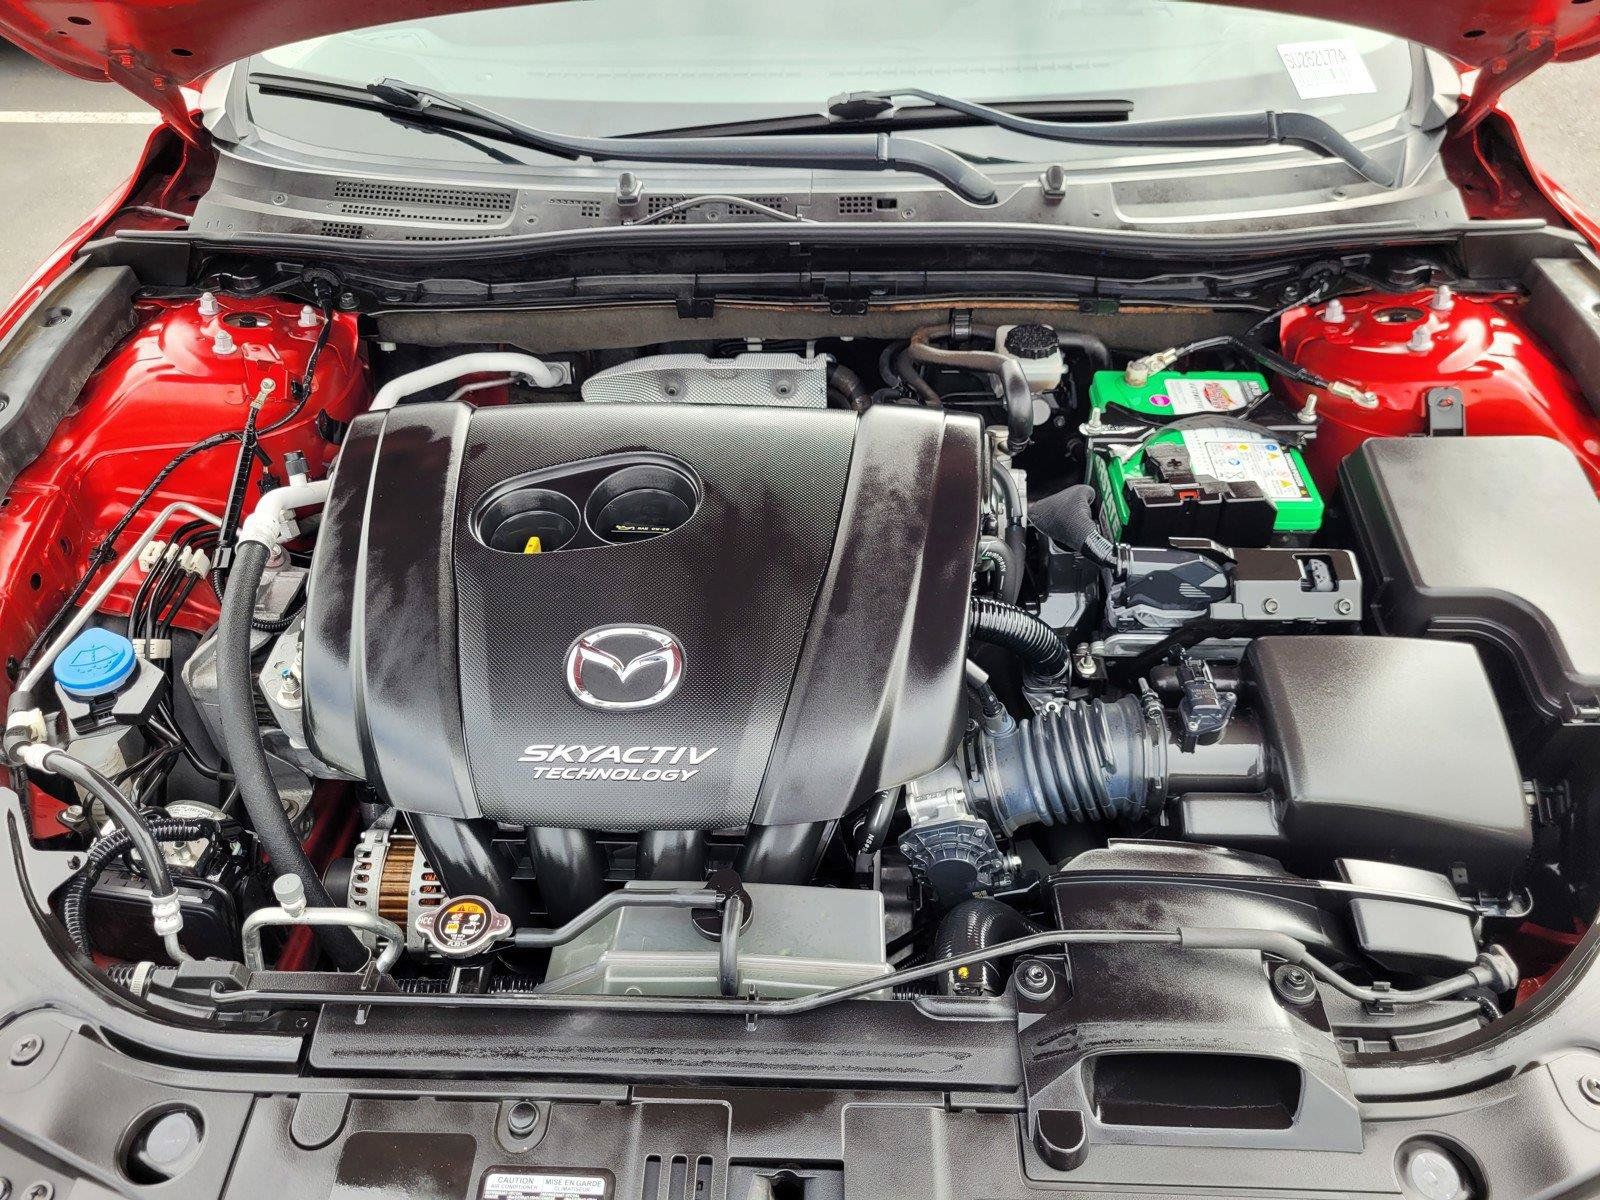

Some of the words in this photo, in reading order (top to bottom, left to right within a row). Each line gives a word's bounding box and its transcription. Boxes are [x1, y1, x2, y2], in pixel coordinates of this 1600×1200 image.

[517, 744, 720, 765] SKYACTIV
[532, 766, 700, 782] TECHNOLOGY
[497, 1176, 535, 1185] CAUTION
[545, 1178, 563, 1186] MISE
[576, 1180, 602, 1188] GARDE
